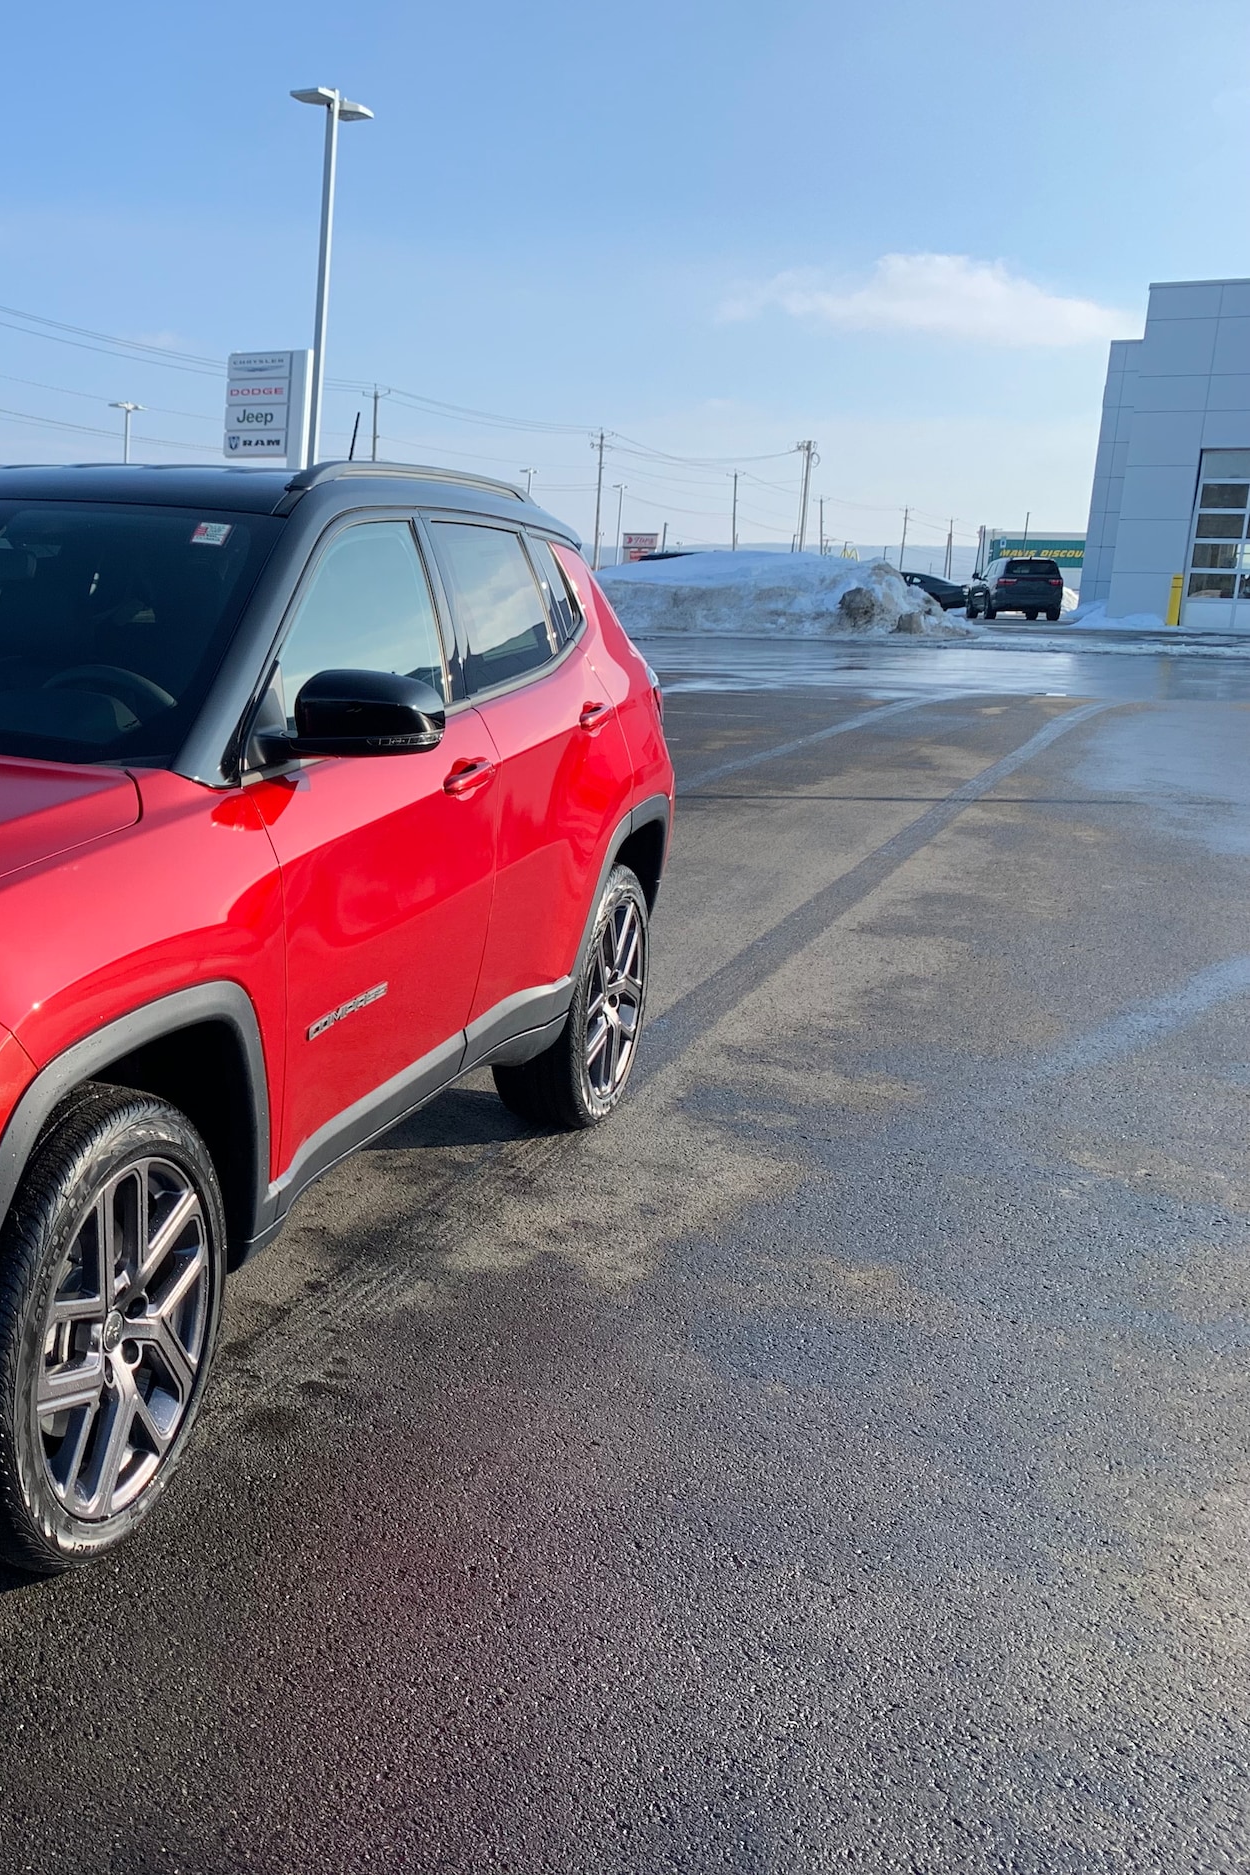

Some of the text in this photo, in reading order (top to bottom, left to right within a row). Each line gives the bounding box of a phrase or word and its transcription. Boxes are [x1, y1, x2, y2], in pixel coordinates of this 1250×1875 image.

[230, 387, 284, 396] DODGE
[236, 409, 274, 426] Jeep
[242, 439, 281, 447] RAM
[999, 548, 1085, 559] MAVIS DISCOU
